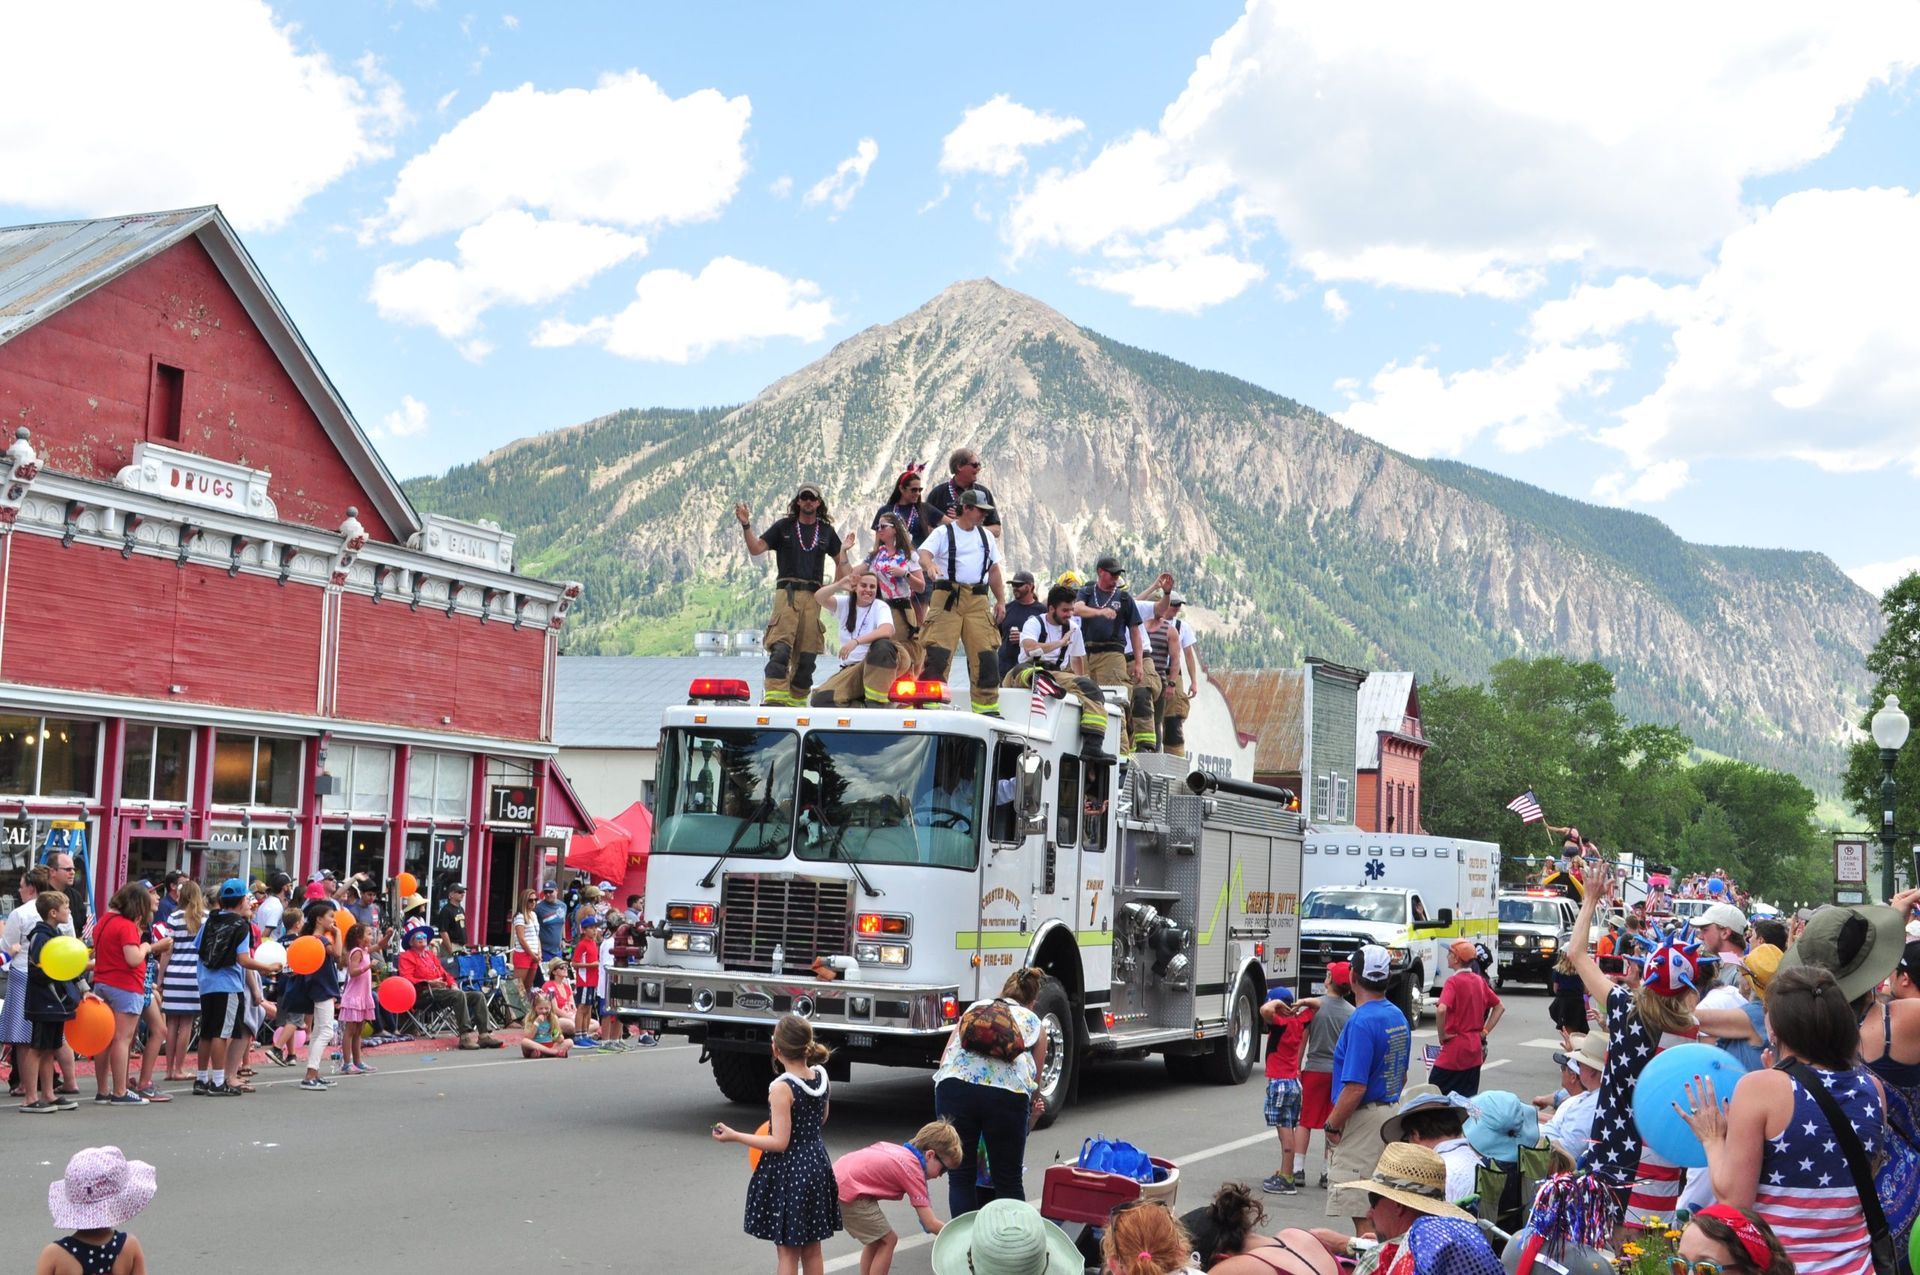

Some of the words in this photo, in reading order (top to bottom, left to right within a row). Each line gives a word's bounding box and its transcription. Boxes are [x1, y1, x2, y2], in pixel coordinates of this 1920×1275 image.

[170, 467, 234, 499] DRUGS
[448, 534, 486, 560] BANK
[494, 789, 535, 820] T-bar
[1, 827, 31, 846] CAL
[257, 835, 289, 851] ART
[434, 838, 462, 869] T-bar
[1086, 880, 1104, 890] ENGINE
[981, 887, 1005, 910] CRESTED
[1005, 889, 1020, 911] BUTTE
[1090, 892, 1098, 926] 1
[1246, 891, 1274, 914] CRESTED
[1276, 892, 1297, 915] BUTTE
